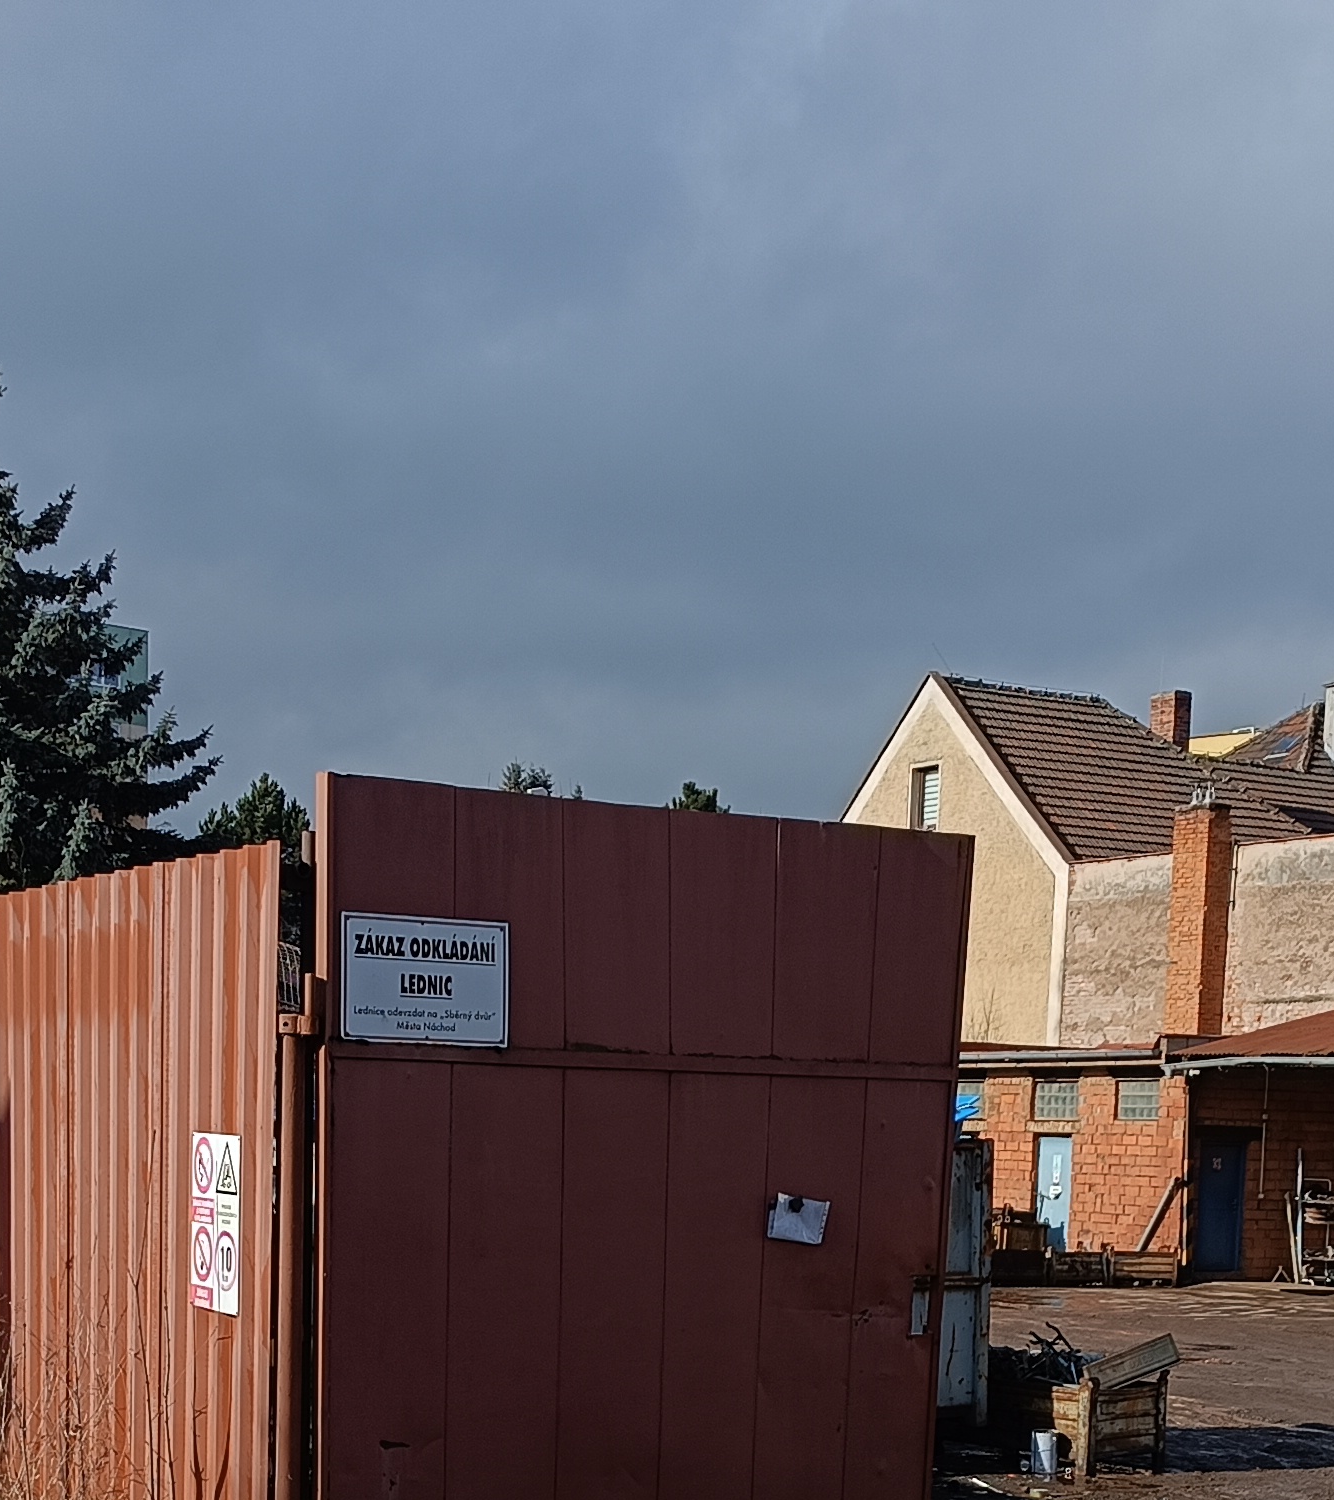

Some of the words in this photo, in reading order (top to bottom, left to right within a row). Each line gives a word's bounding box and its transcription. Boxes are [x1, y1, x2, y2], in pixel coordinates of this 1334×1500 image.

[354, 928, 405, 957] ZÁKAZ
[410, 934, 496, 962] ODKLÁDÁNÍ
[400, 973, 453, 996] LEDNIC
[354, 1005, 385, 1016] Lednice
[387, 1007, 425, 1018] odevzdat
[427, 1010, 437, 1018] na
[396, 1021, 421, 1031] Města
[423, 1021, 455, 1032] Náchod
[221, 1246, 232, 1272] 10
